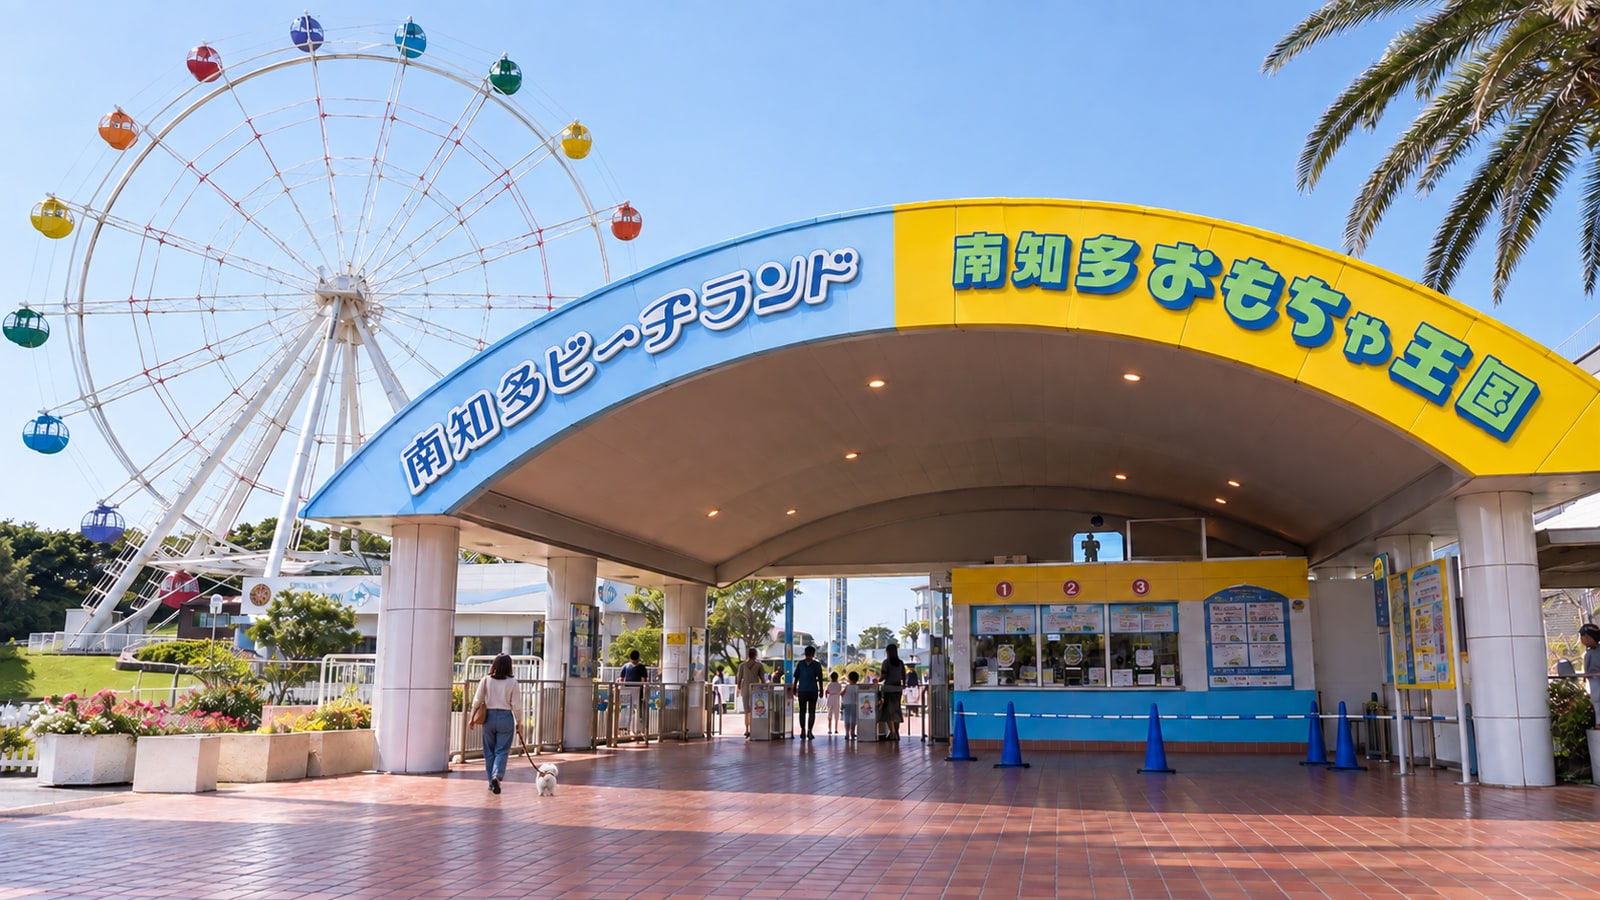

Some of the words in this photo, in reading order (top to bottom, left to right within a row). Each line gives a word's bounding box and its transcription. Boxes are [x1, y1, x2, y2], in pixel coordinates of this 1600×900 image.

[402, 247, 859, 495] 南知多ビーチランド
[953, 231, 1541, 442] 南知多おもちゃ王国
[1067, 582, 1076, 594] 2
[1136, 581, 1145, 593] 3
